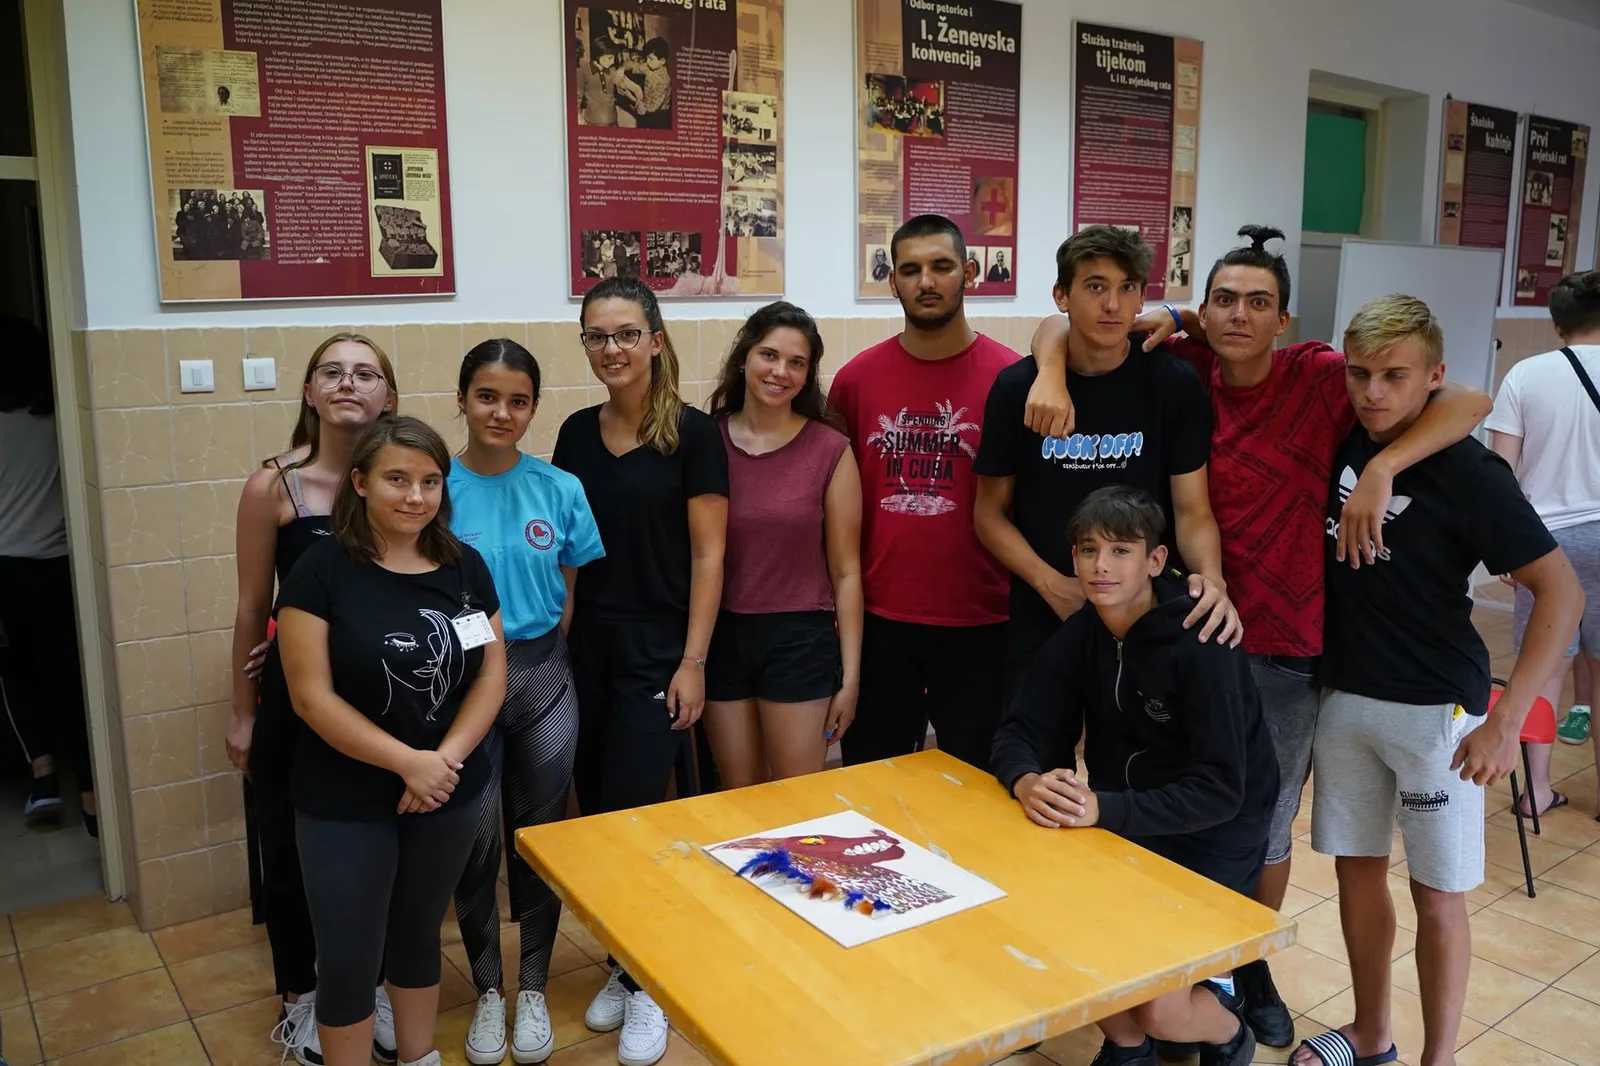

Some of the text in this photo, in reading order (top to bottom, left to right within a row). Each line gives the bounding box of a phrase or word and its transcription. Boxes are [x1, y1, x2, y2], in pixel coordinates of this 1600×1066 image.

[699, 0, 727, 11] rata
[910, 0, 935, 11] Odbor
[936, 2, 969, 17] petorice
[920, 15, 1016, 54] I. Ženevska
[1081, 32, 1145, 55] Služba traženja
[911, 43, 982, 70] konvencija
[1096, 50, 1147, 74] tijekom
[1128, 75, 1158, 91] svjetskog
[1158, 80, 1172, 91] rata
[1530, 130, 1549, 148] Prvi
[1532, 148, 1567, 165] svjetski rat
[901, 414, 946, 426] SPENDING
[885, 431, 961, 454] SUMMER
[1042, 431, 1144, 460] FUCK OFF!
[887, 459, 954, 481] IN CUBA
